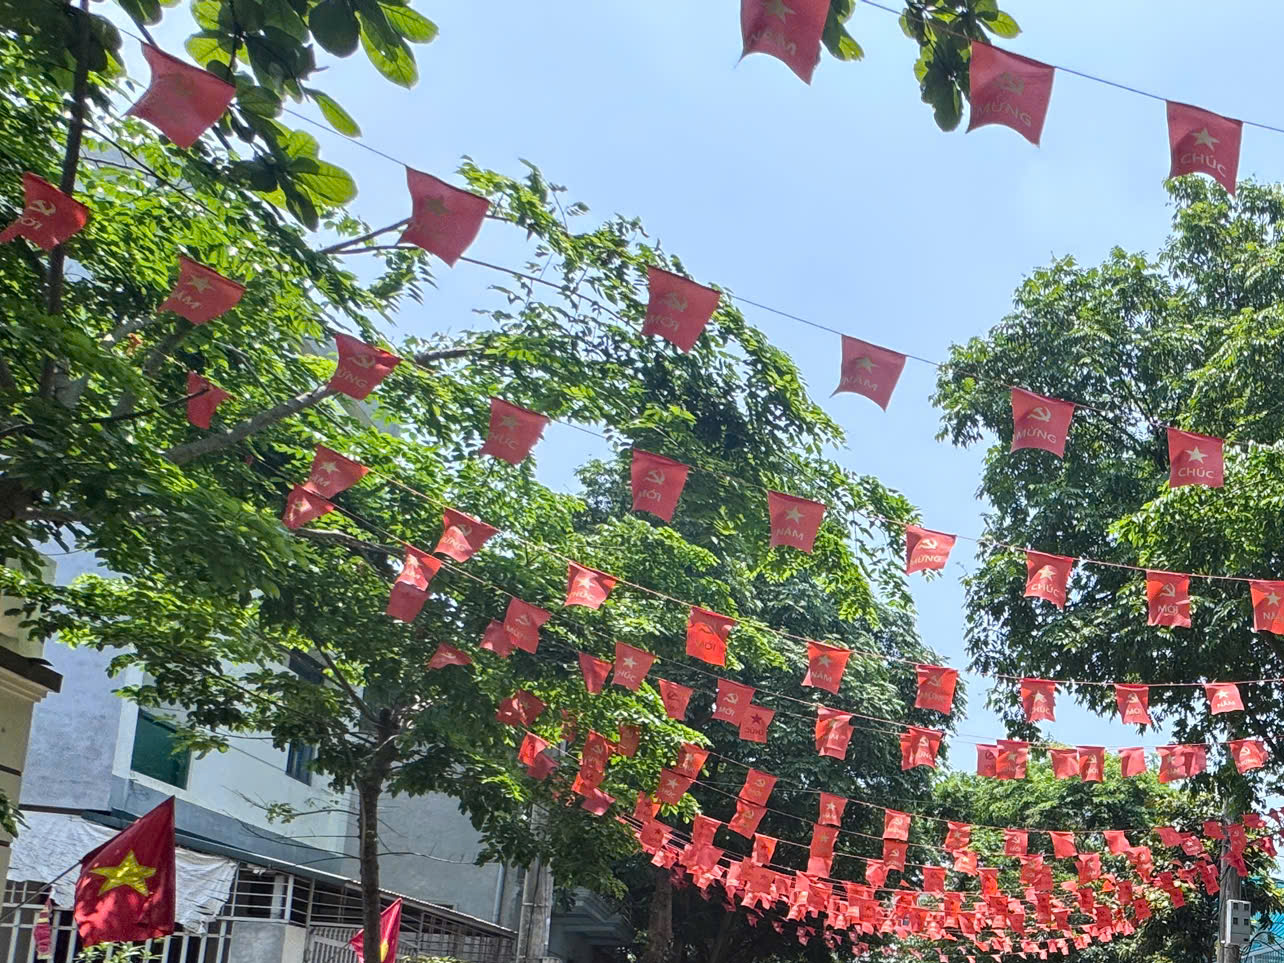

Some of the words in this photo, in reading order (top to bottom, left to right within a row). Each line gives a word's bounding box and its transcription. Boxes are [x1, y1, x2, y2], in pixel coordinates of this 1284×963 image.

[1180, 154, 1227, 178] CHÚC
[1015, 426, 1057, 445] MỪNG
[1177, 464, 1216, 480] CHÚC
[1030, 583, 1060, 598] CHÚC
